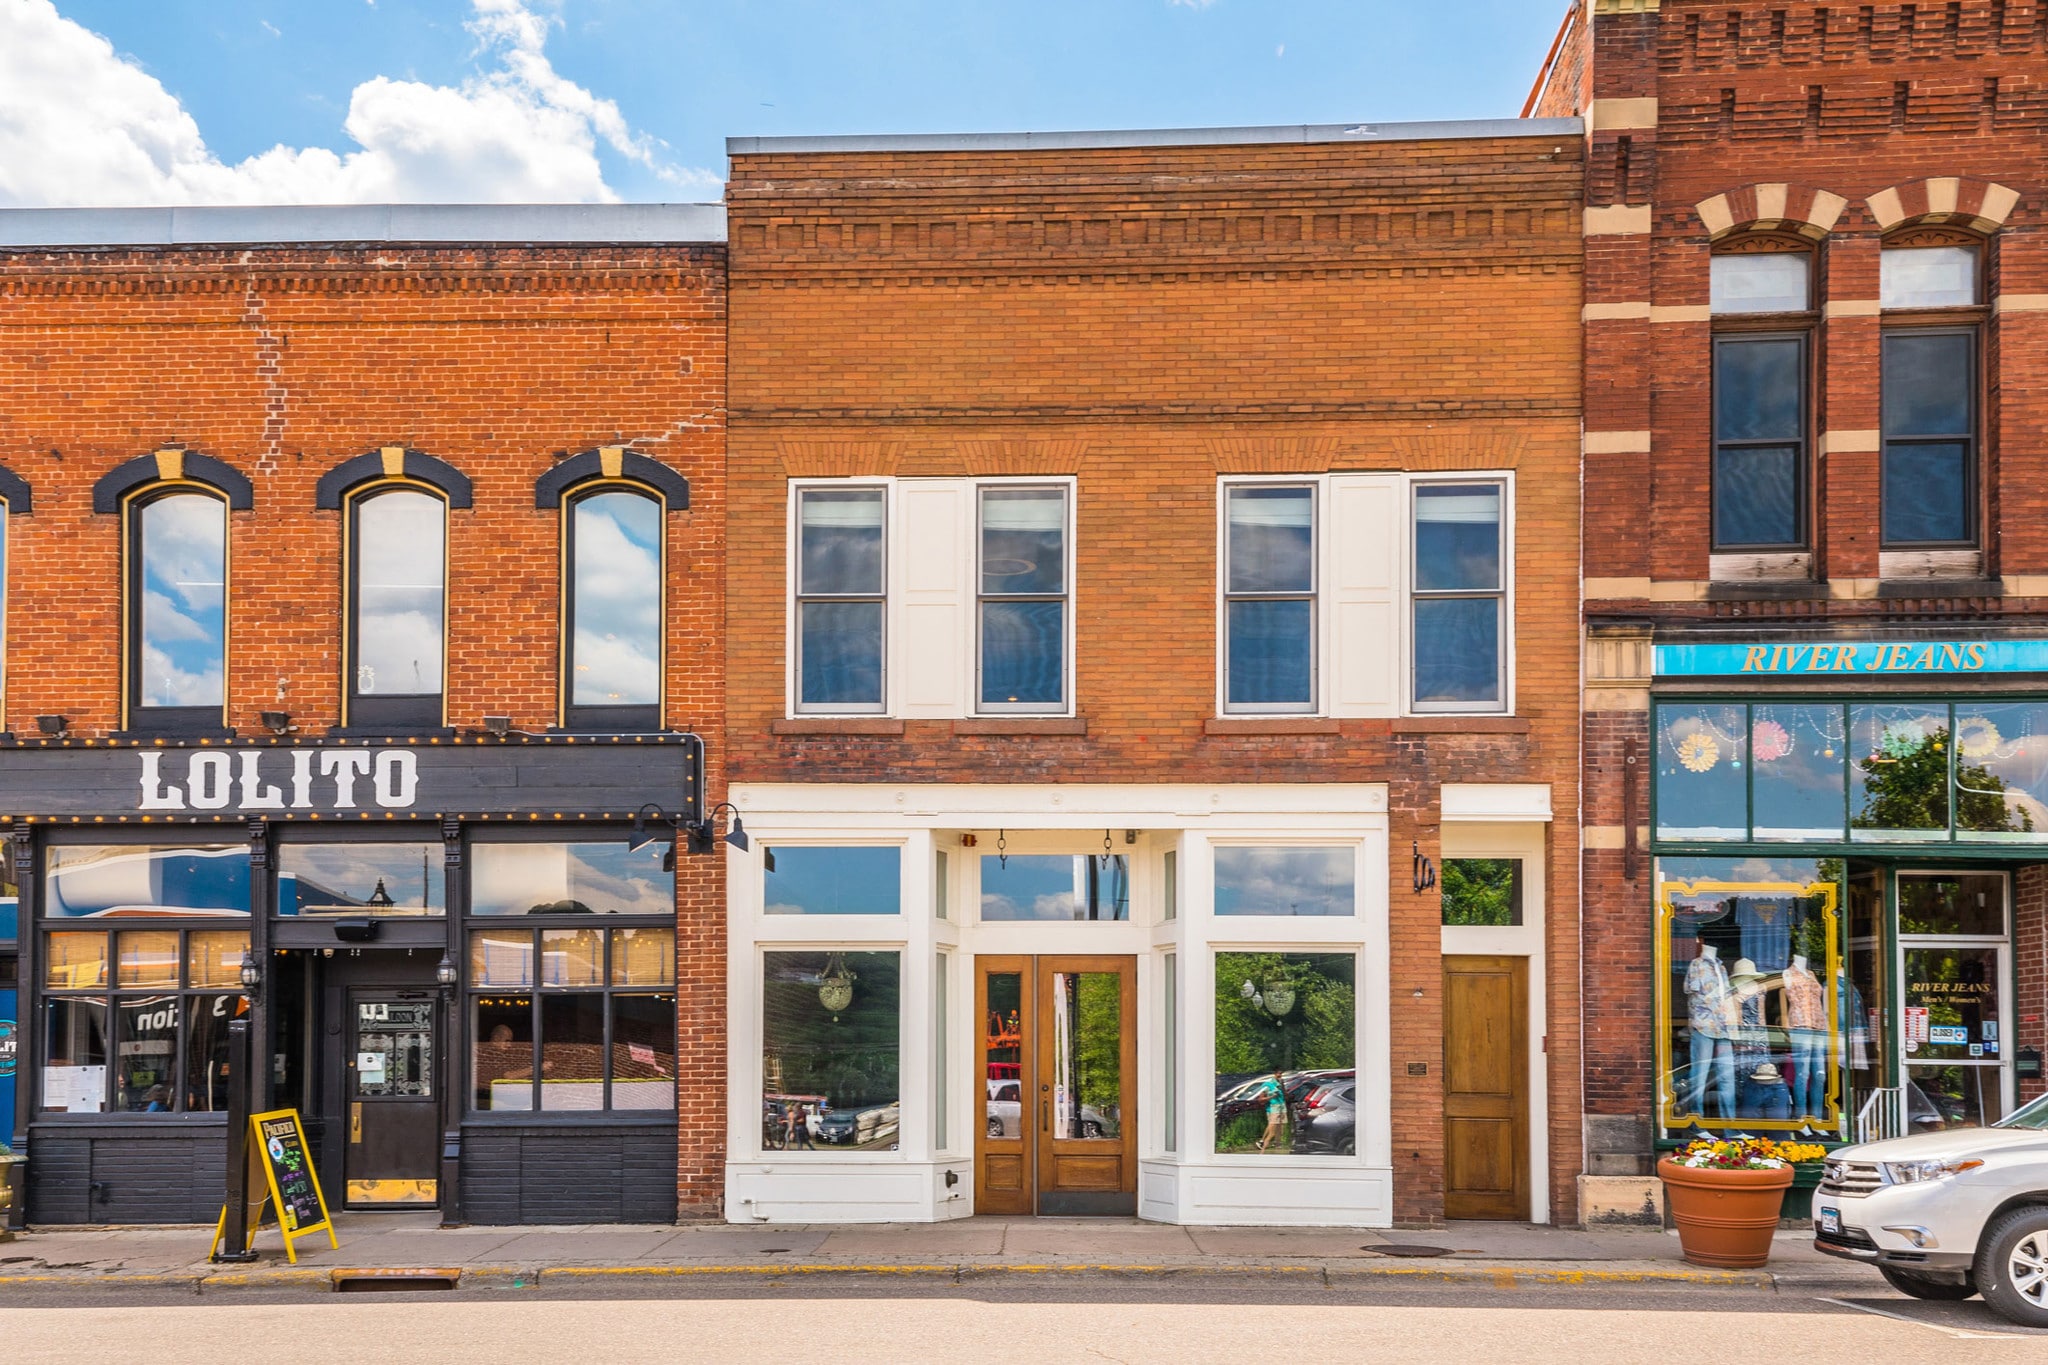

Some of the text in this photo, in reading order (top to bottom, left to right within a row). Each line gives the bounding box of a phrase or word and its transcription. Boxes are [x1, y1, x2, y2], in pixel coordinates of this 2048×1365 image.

[1741, 643, 1987, 672] RIVER JEANS
[138, 750, 420, 810] LOLITO
[1912, 983, 1991, 992] RIVER JEANS
[1932, 1028, 1953, 1037] CLOSED
